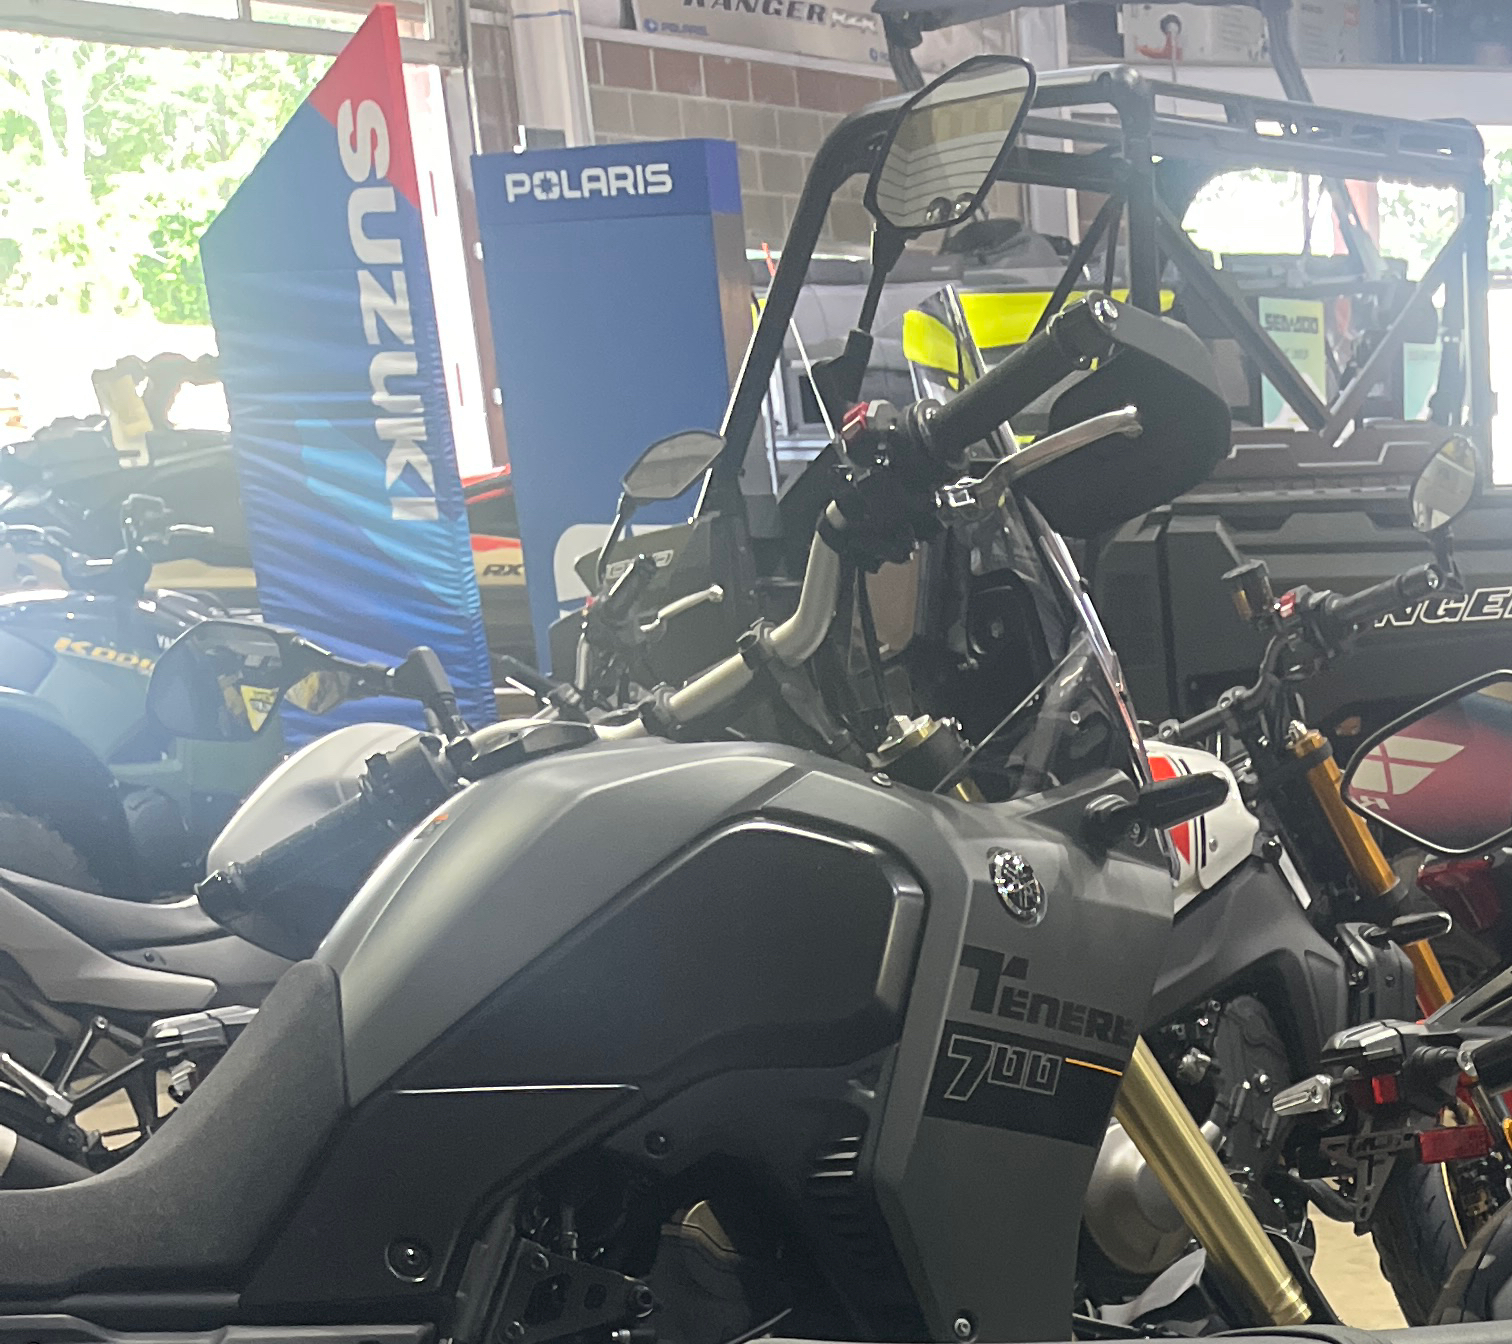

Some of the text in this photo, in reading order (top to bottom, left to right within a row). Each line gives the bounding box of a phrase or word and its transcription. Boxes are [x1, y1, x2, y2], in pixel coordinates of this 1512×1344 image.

[505, 162, 673, 203] POLARIS
[337, 99, 439, 521] SUZUKI
[944, 1034, 1063, 1101] 700
